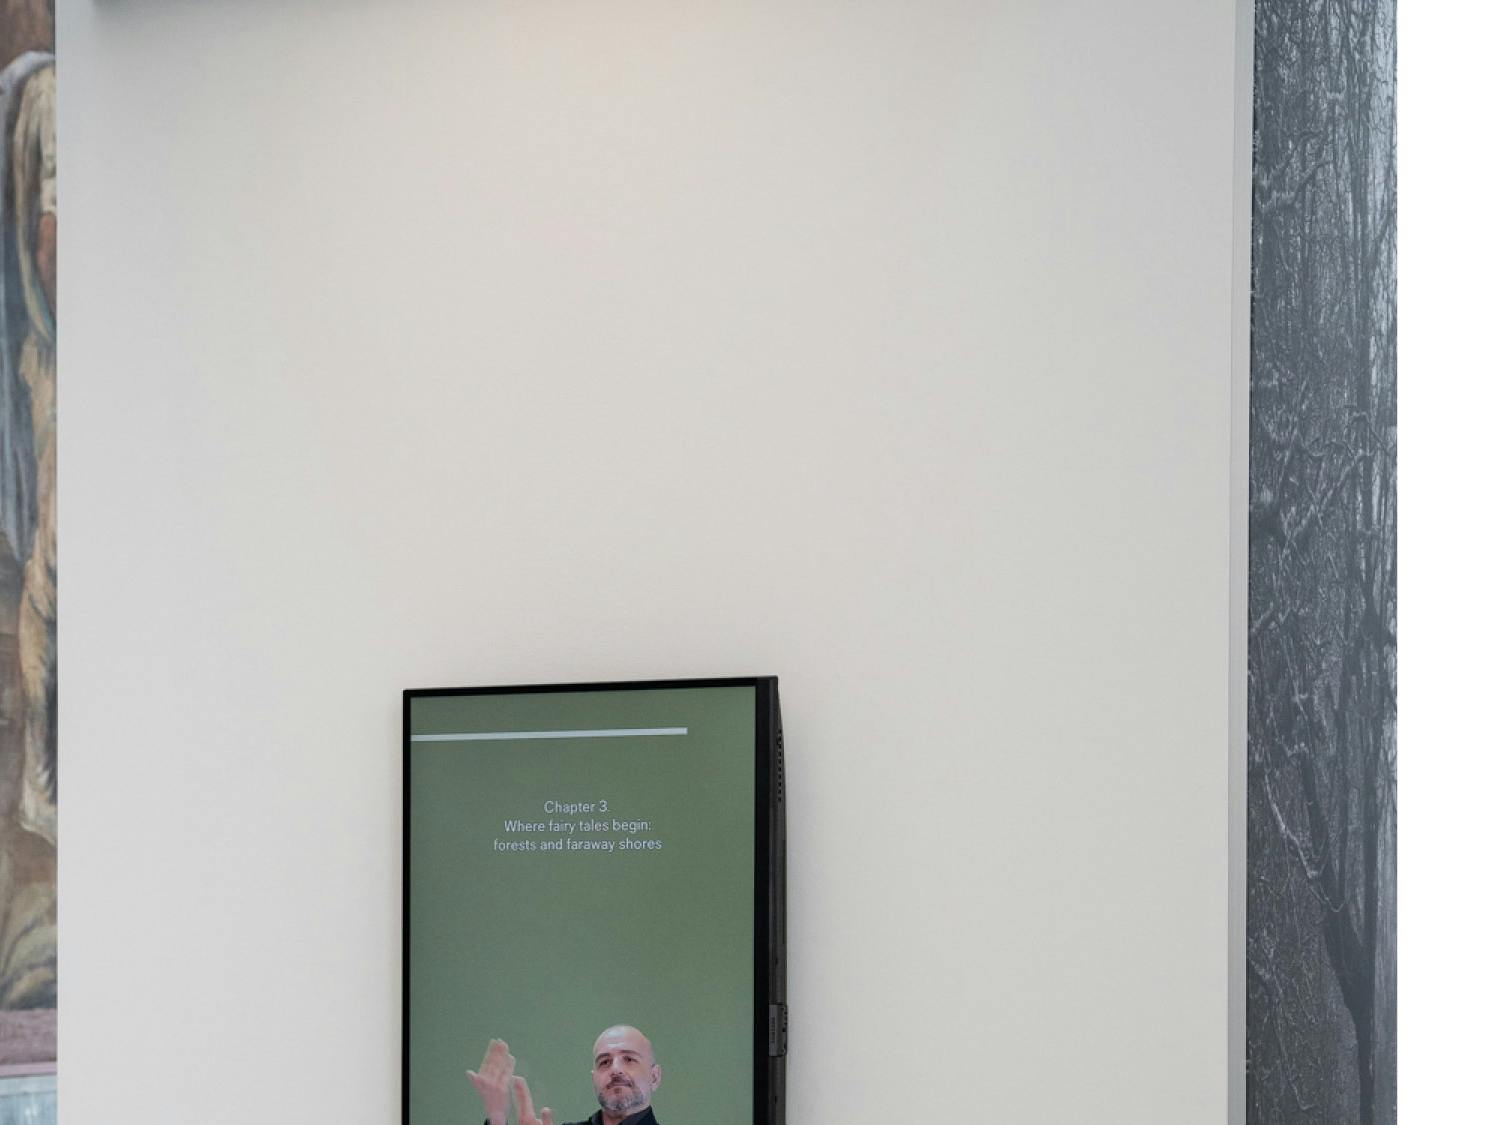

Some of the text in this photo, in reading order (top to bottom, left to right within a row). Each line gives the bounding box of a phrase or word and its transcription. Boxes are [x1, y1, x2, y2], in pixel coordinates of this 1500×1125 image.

[544, 800, 595, 815] Chapter
[504, 818, 651, 835] Where fairy tales begin:
[494, 837, 662, 852] forests and faraway shores
